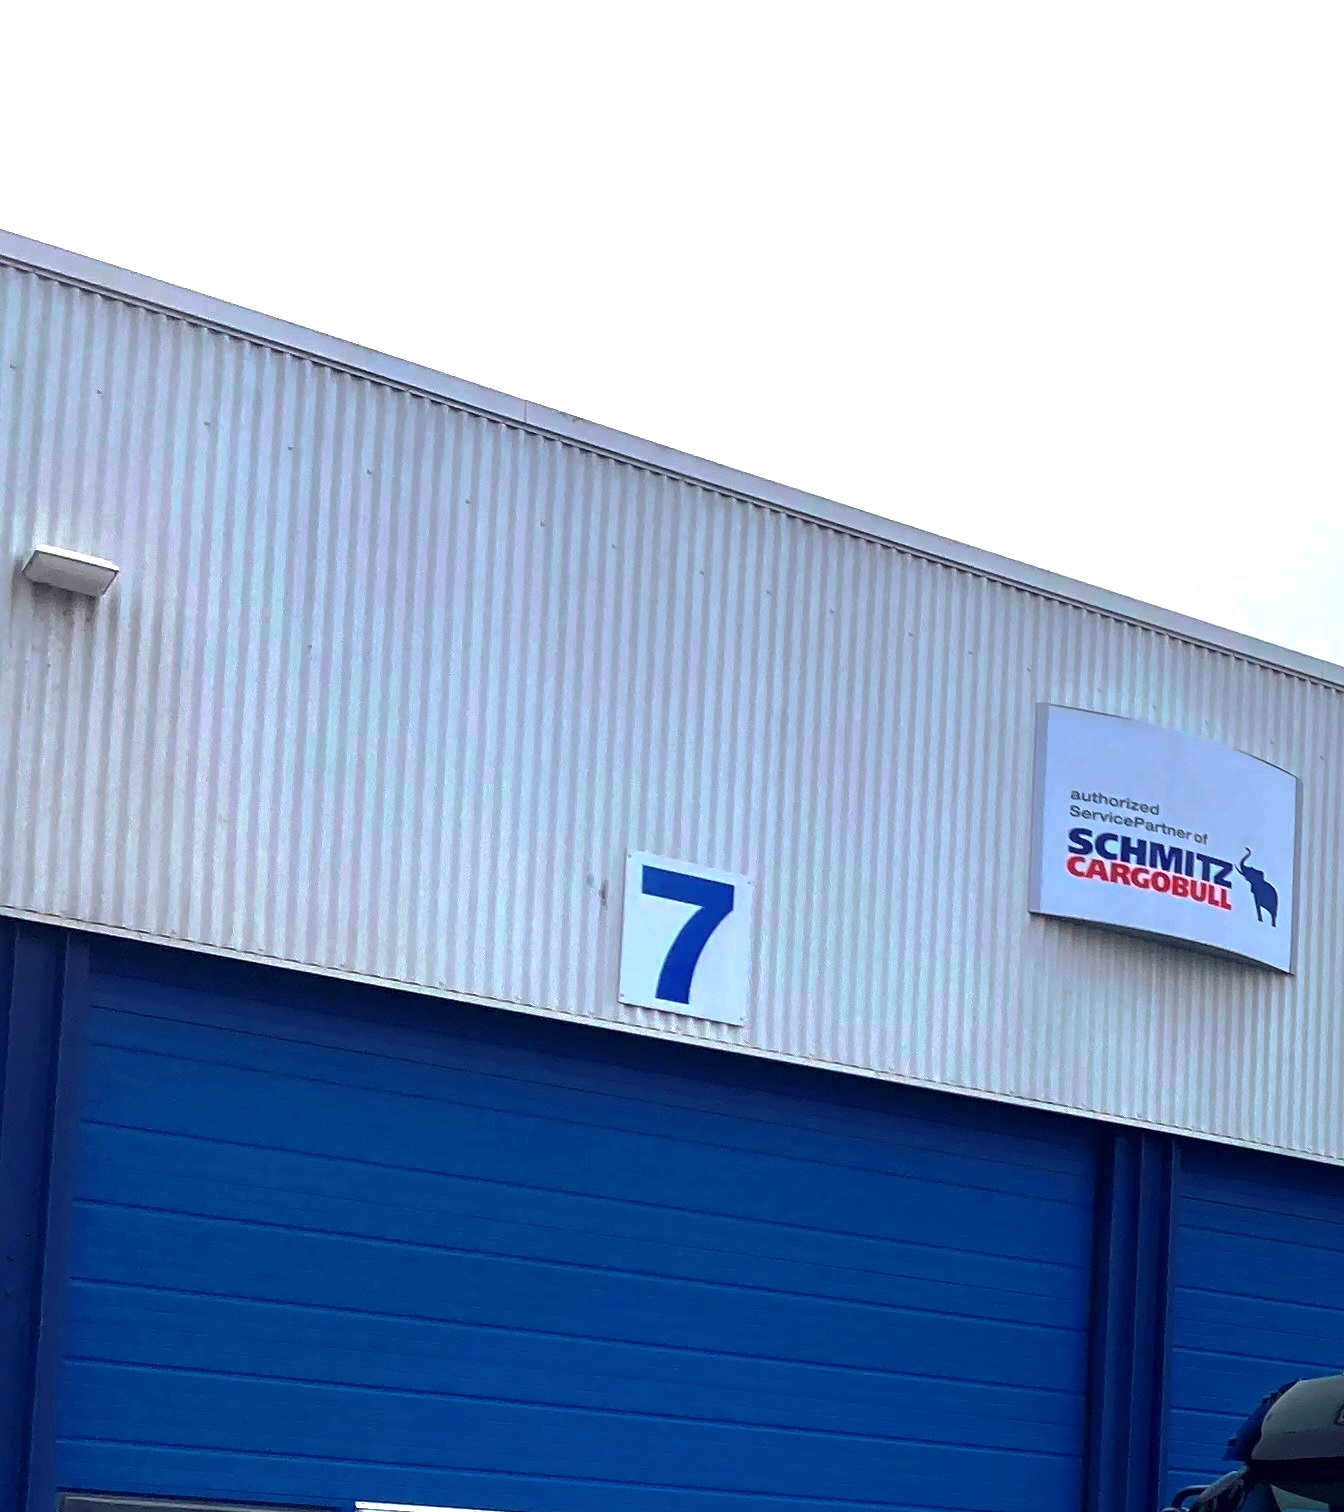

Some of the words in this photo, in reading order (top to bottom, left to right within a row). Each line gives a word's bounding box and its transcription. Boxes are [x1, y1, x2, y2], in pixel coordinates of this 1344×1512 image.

[1070, 790, 1160, 816] authorized
[1067, 827, 1234, 890] SCHMITZ
[1194, 834, 1209, 846] of
[1066, 855, 1233, 911] CARGOBULL
[641, 864, 735, 1005] 7
